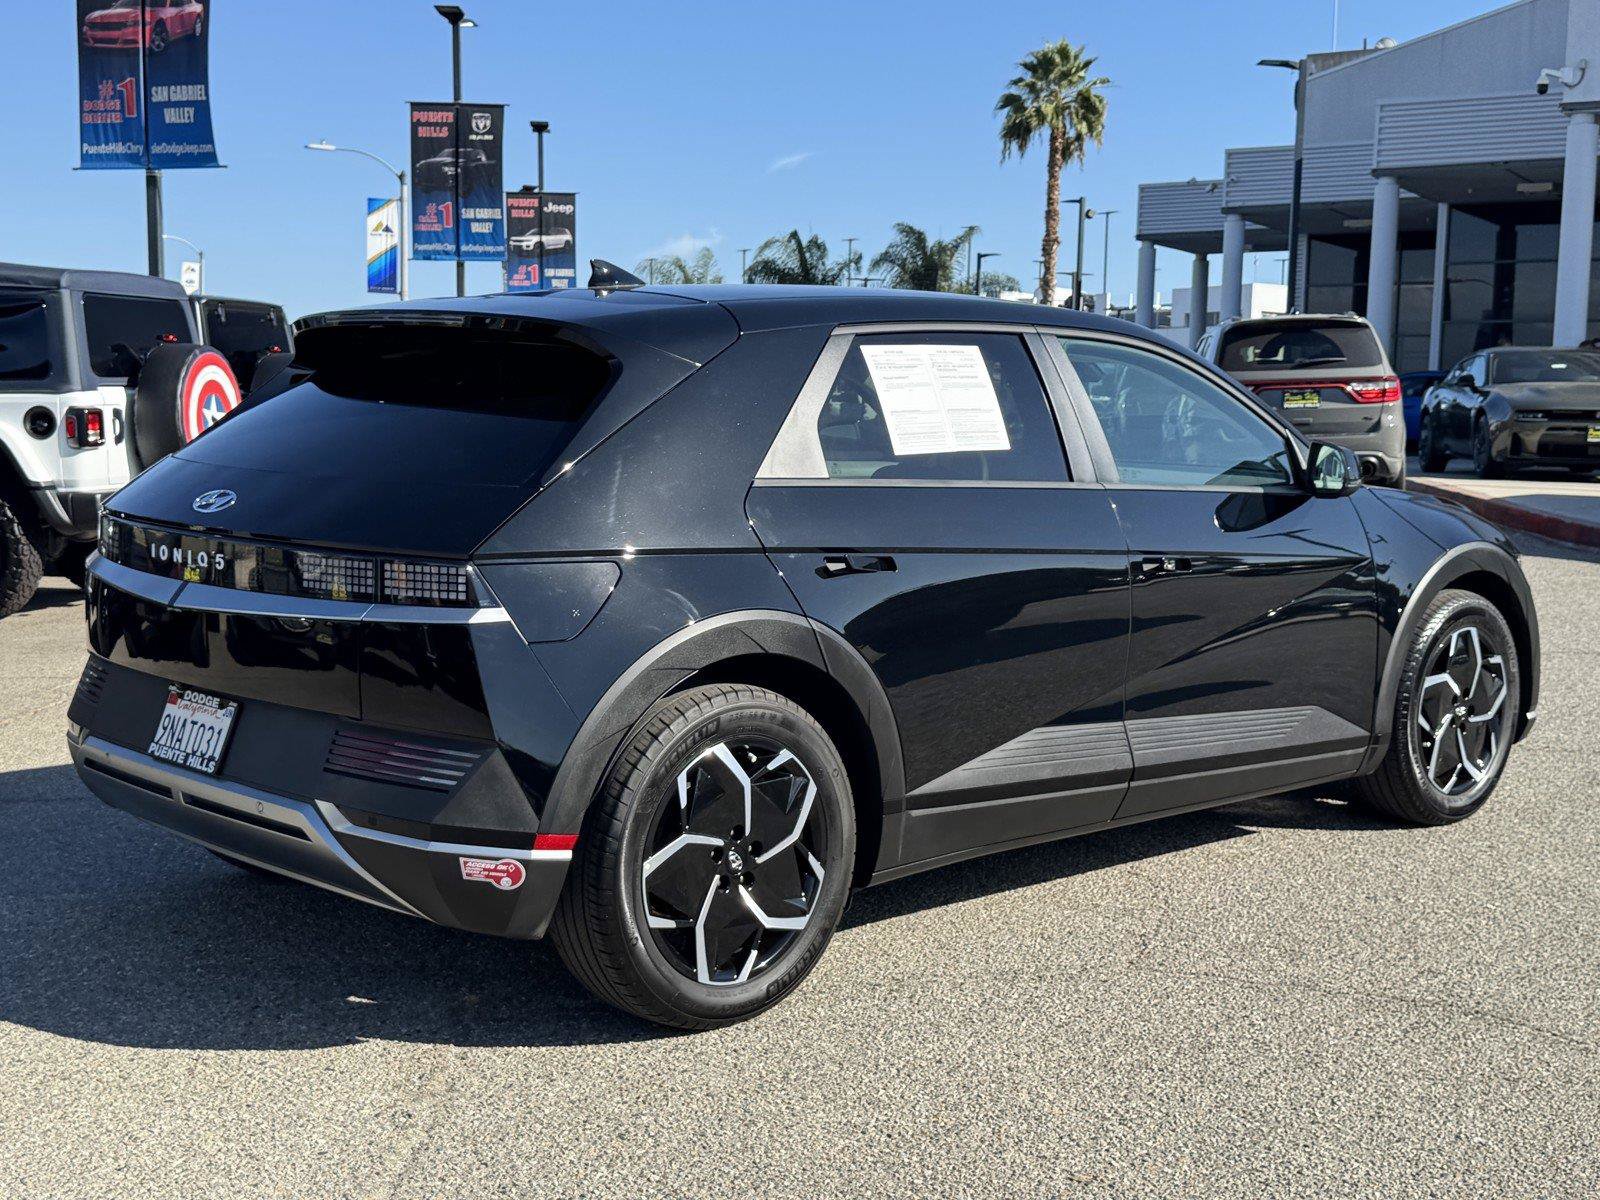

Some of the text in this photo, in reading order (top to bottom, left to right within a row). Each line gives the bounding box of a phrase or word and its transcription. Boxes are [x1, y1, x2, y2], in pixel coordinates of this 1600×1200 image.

[151, 85, 206, 102] SAN GABRIEL
[163, 107, 195, 124] VALLEY
[412, 111, 454, 123] PUENTE
[418, 126, 449, 137] HILLS
[462, 208, 475, 219] SAN
[543, 202, 574, 215] Jeep
[471, 222, 493, 233] VALLEY
[151, 543, 225, 570] IONIQ 5
[183, 690, 220, 708] DODGE
[177, 700, 221, 719] California
[156, 713, 222, 760] 9NAT031
[148, 742, 216, 773] PUENTE HILLS
